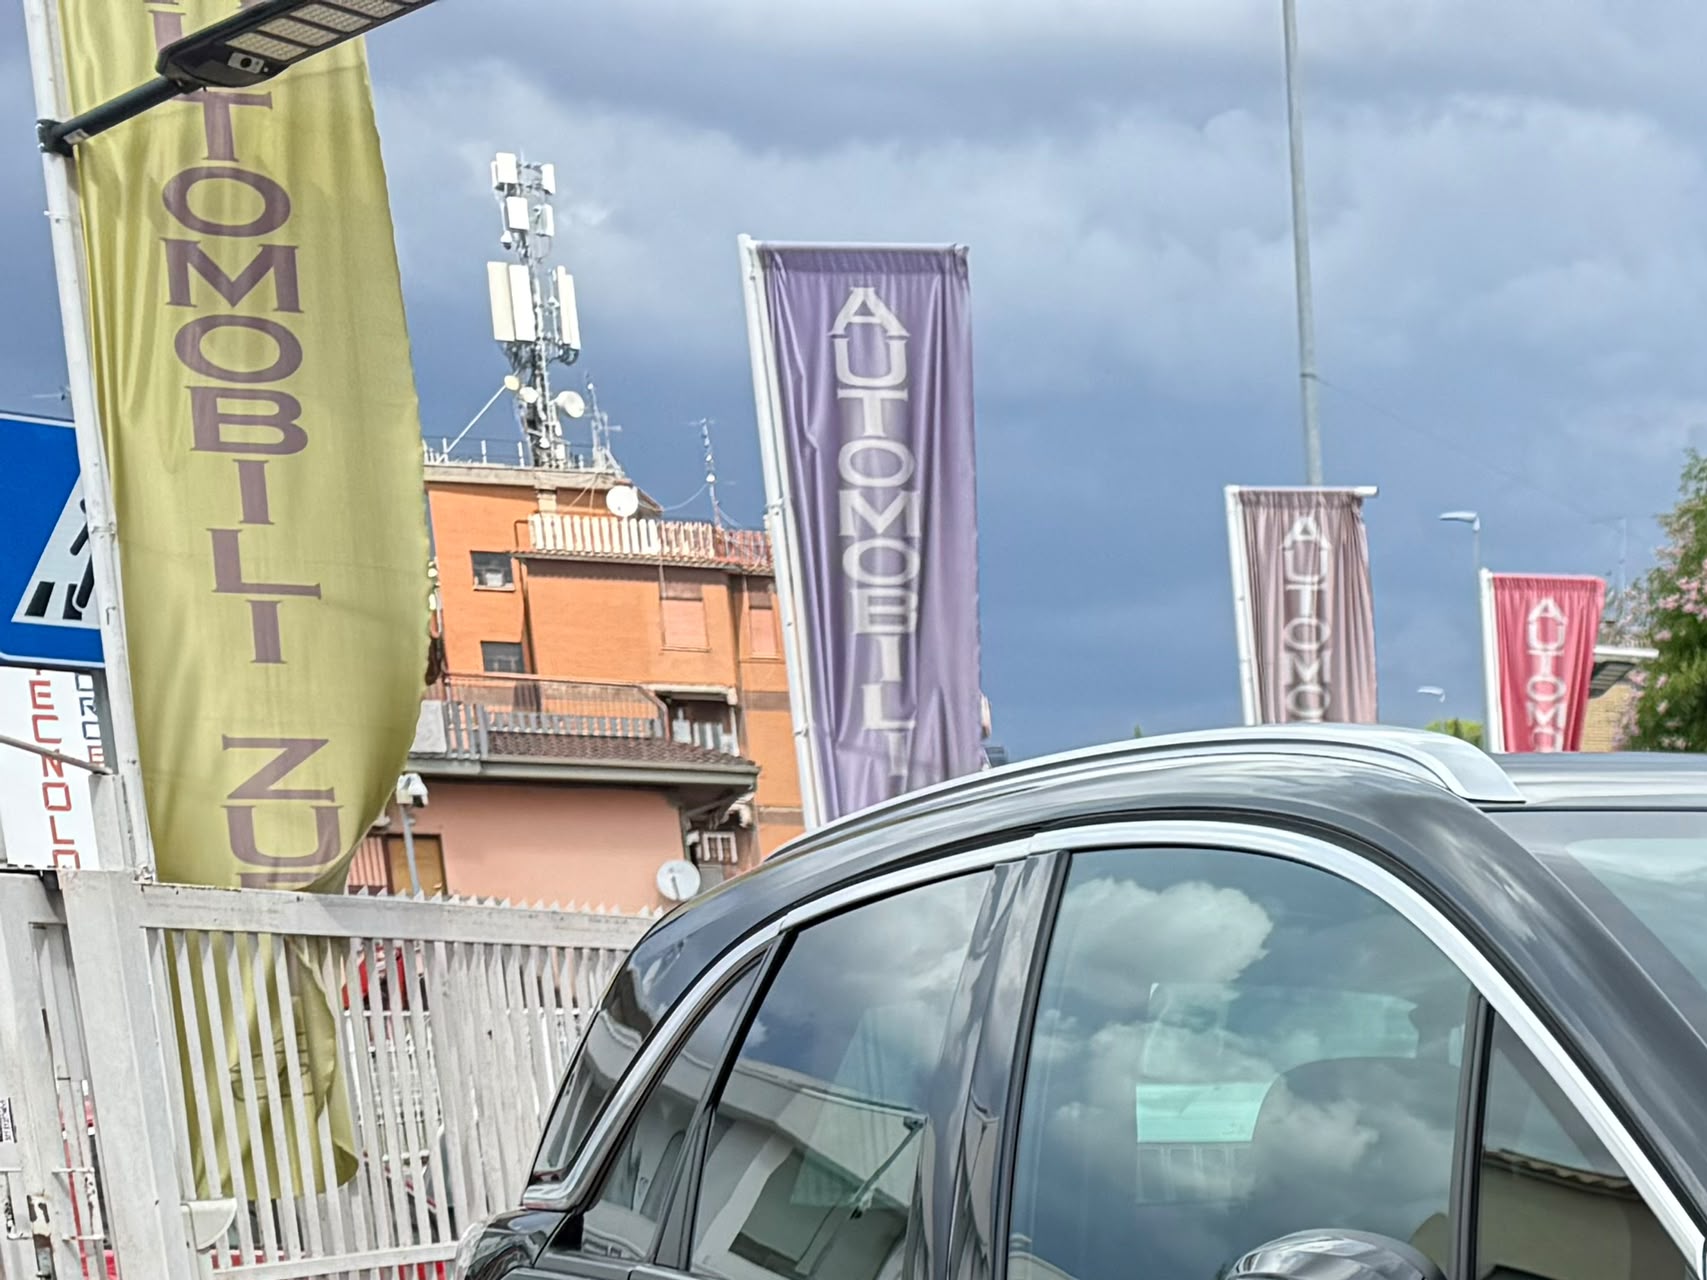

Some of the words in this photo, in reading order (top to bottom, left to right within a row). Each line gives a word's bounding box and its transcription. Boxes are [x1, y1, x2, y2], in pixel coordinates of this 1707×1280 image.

[145, 0, 321, 665] TOMOBILI
[829, 286, 921, 777] AUTOMOBILI
[1280, 516, 1333, 722] AUTOMO
[221, 734, 344, 889] ZU
